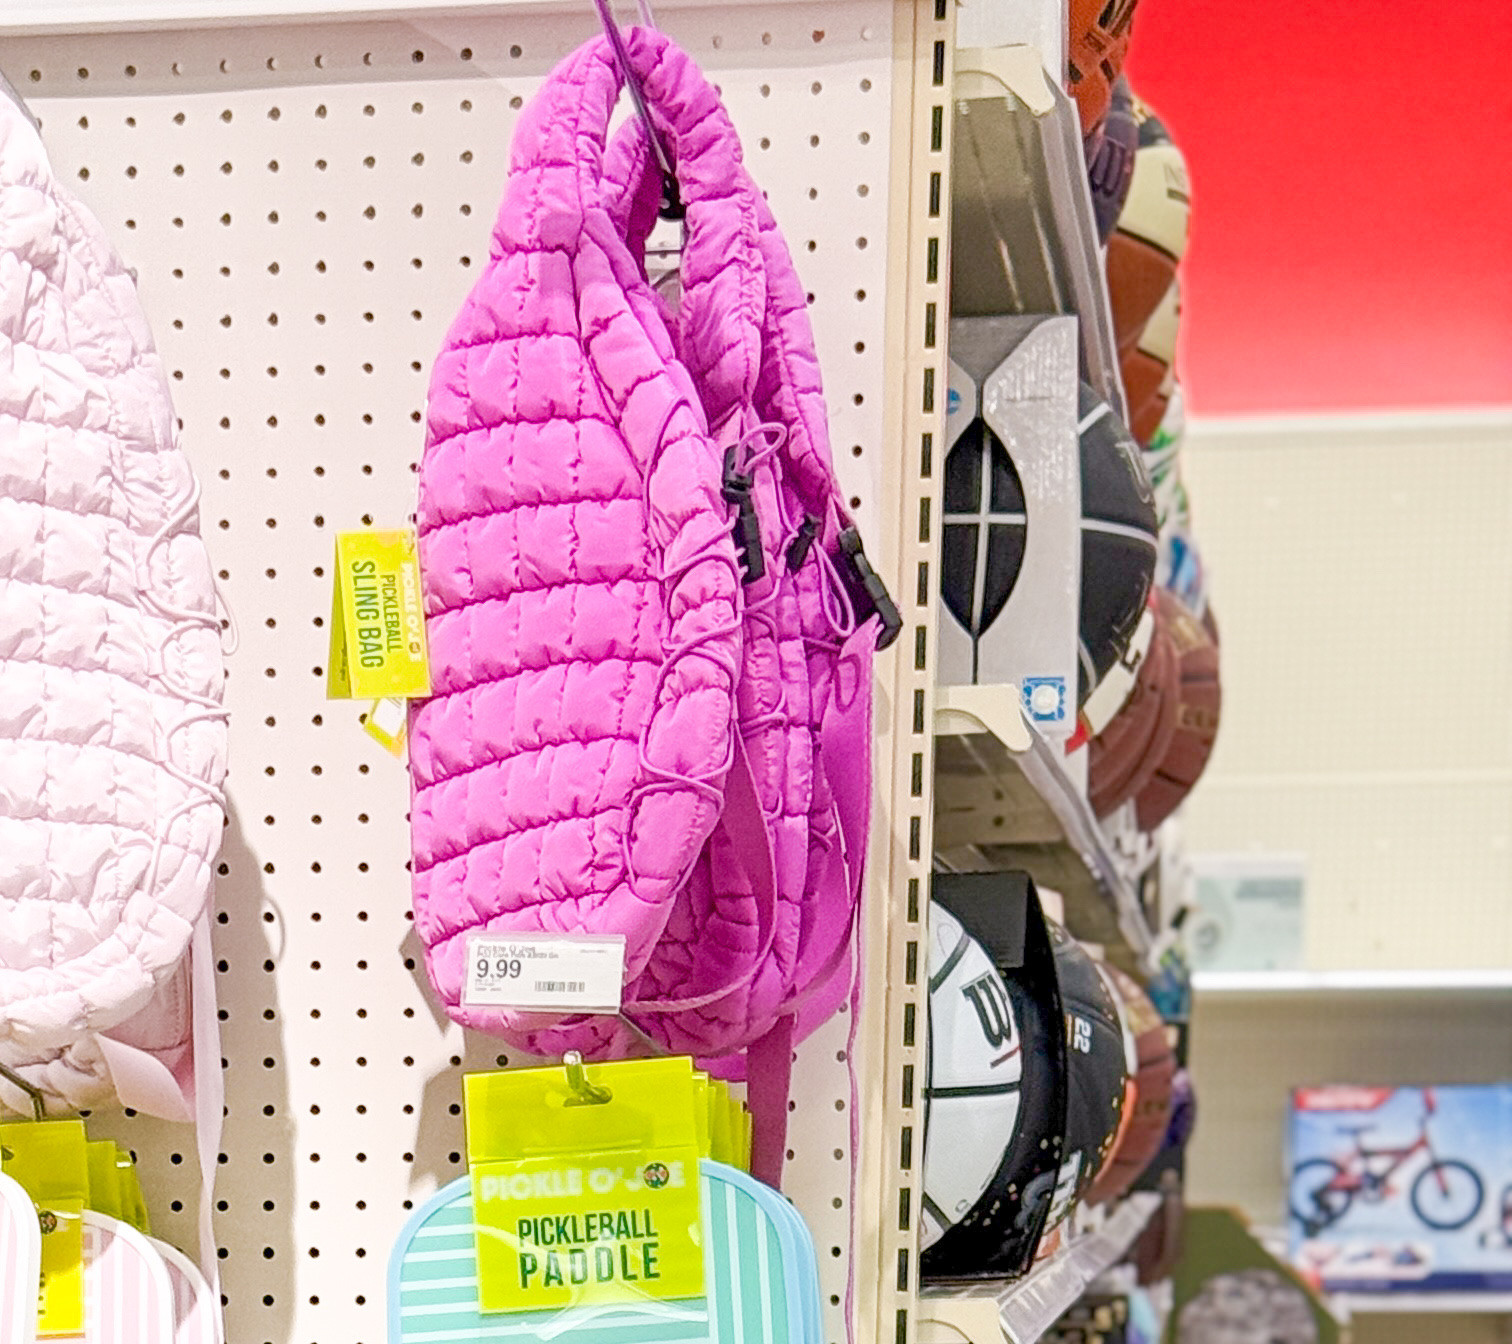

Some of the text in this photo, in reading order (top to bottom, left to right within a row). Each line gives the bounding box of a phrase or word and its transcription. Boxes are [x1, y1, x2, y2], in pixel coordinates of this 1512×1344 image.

[352, 561, 384, 668] SLING BAG
[380, 574, 403, 653] PICKLEBALL
[477, 959, 521, 978] 9.99
[481, 1167, 583, 1202] PICKLE
[518, 1209, 658, 1247] PICKLEBALL
[520, 1242, 661, 1289] PADDLE
